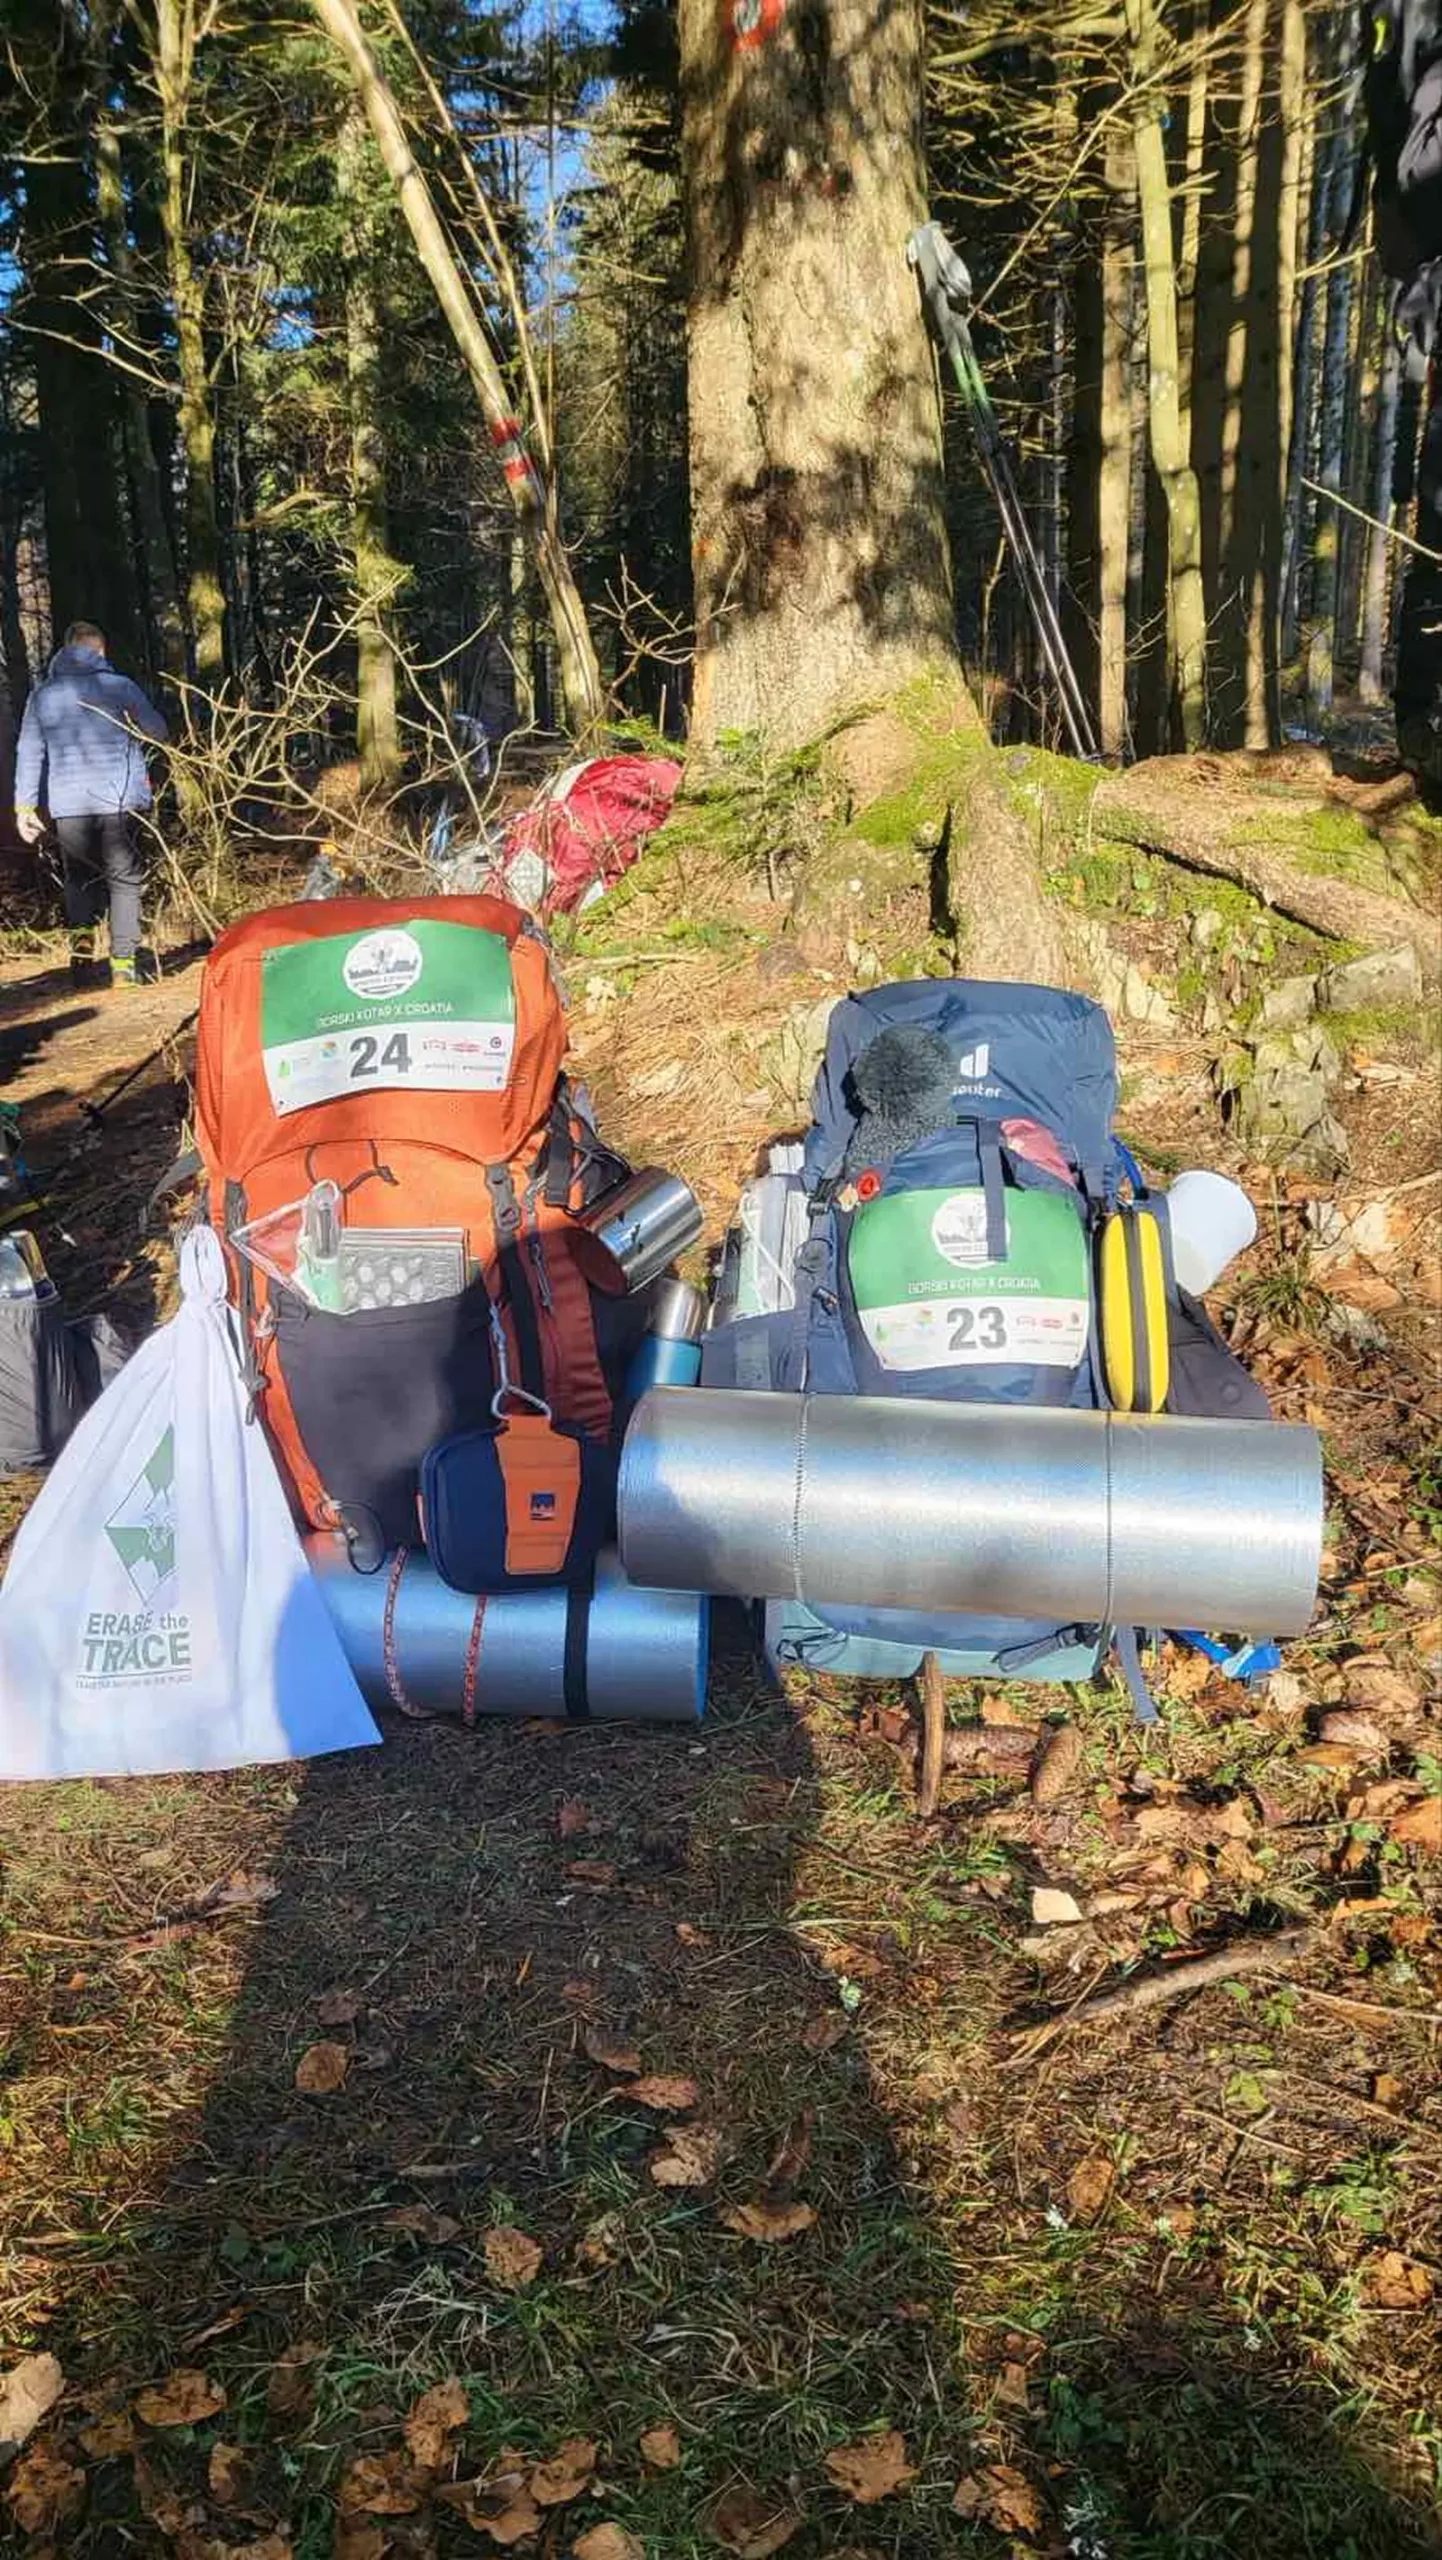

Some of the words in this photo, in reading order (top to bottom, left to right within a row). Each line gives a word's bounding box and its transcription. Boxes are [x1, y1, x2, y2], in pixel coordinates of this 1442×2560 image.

[405, 1002, 454, 1015] CROATIA
[350, 1032, 412, 1078] 24
[946, 1305, 1008, 1351] 23
[87, 1612, 153, 1636] ERASE
[159, 1612, 189, 1629] the
[82, 1632, 191, 1673] TRACE
